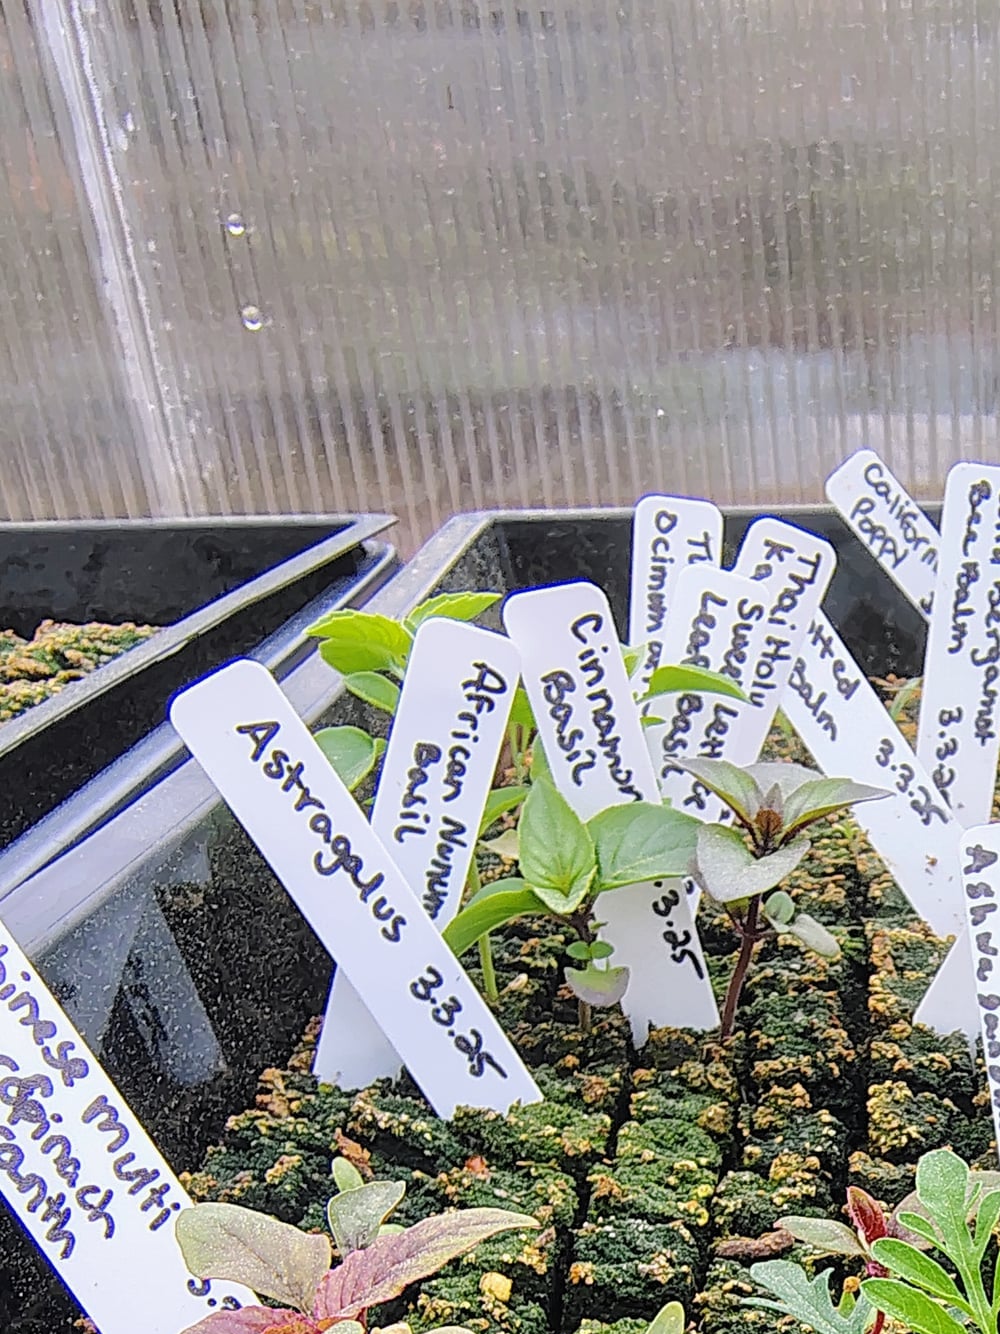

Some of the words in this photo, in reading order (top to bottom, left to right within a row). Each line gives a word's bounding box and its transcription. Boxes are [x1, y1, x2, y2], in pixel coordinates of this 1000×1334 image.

[962, 480, 992, 557] Bee
[767, 553, 821, 632] Thai
[947, 561, 980, 655] Balm
[394, 742, 441, 842] Basil
[684, 703, 738, 810] Lettce
[236, 721, 407, 942] Astragalus
